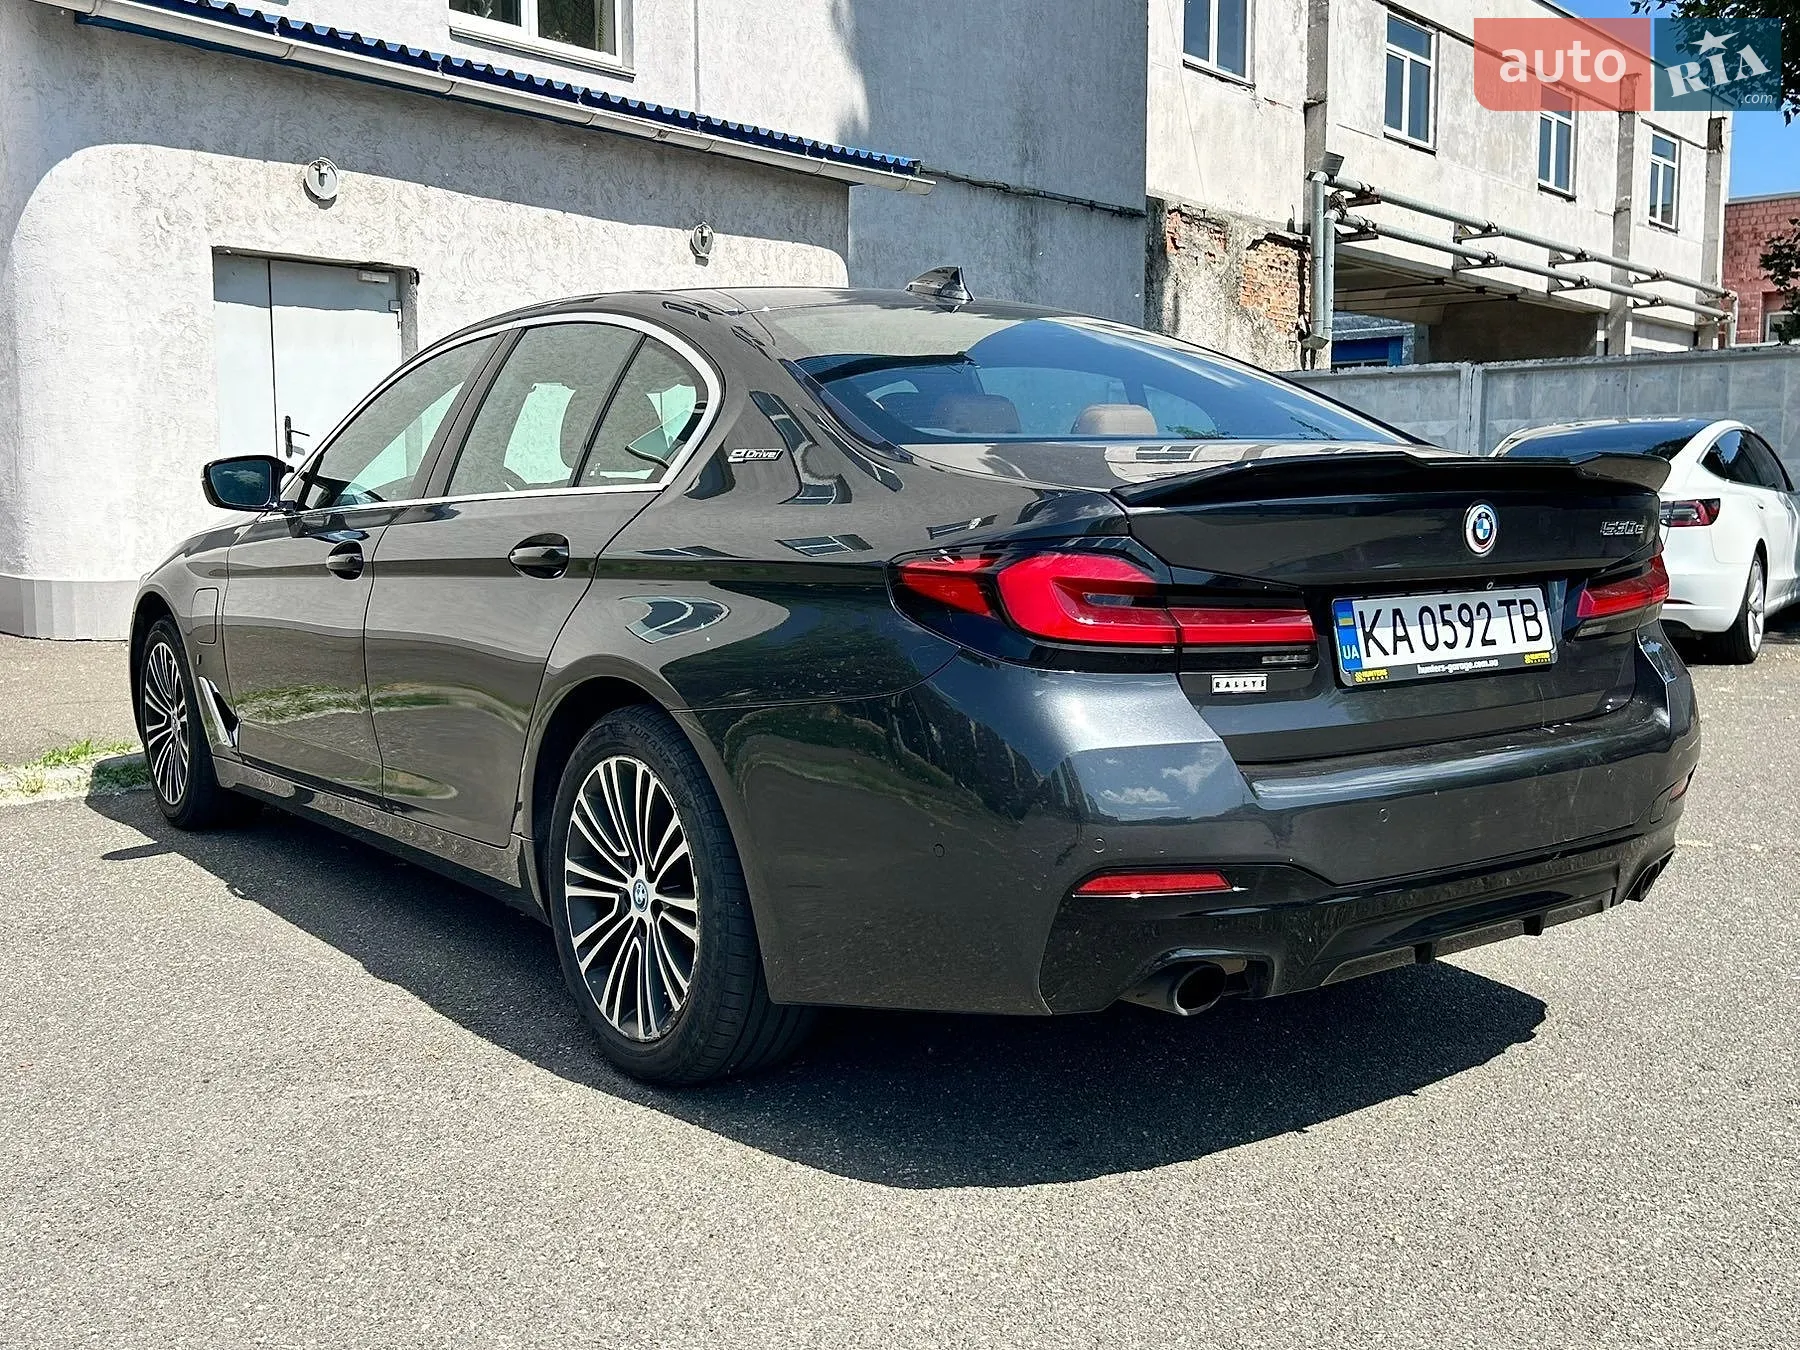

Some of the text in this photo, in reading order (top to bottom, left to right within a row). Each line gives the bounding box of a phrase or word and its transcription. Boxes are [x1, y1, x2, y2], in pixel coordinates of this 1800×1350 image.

[1358, 598, 1544, 658] KA 0592 TB
[1342, 644, 1360, 660] UA
[1416, 659, 1499, 674] hunters-garage.com.ua
[1215, 680, 1265, 689] RALLYE
